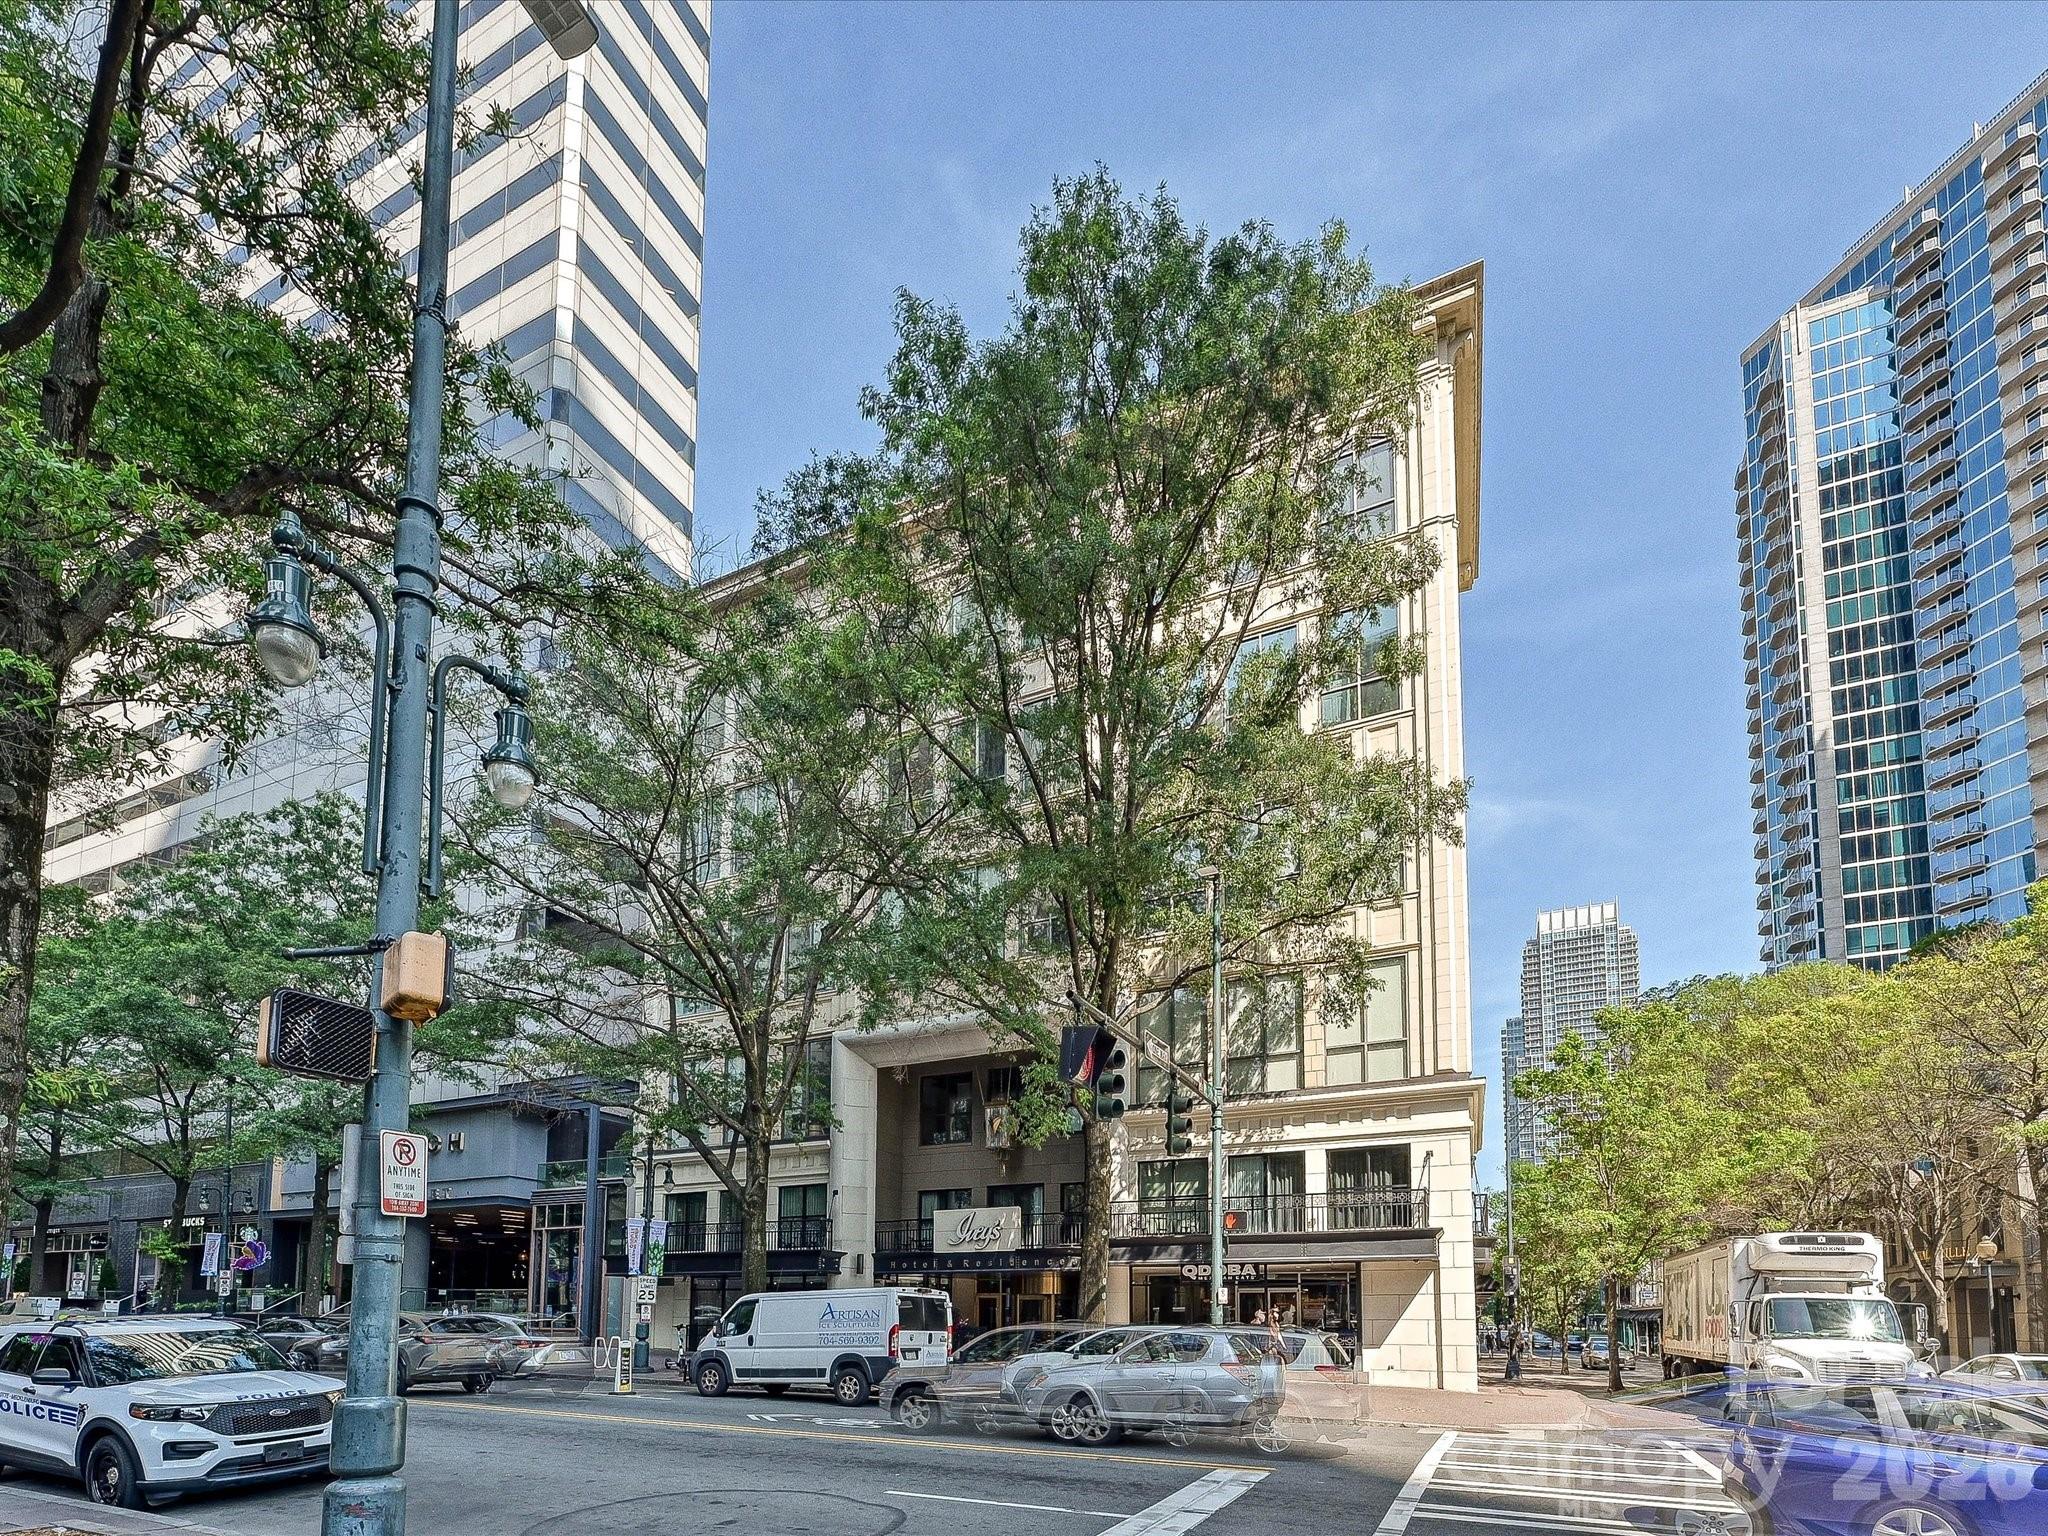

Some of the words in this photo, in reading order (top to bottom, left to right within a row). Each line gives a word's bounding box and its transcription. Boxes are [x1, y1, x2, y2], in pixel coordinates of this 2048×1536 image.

[387, 1165, 421, 1178] ANYTIME
[393, 1182, 404, 1190] THIS
[890, 1258, 938, 1269] Hotel
[639, 1290, 655, 1300] 25
[236, 1388, 308, 1401] POLICE
[0, 1399, 60, 1423] OLICE
